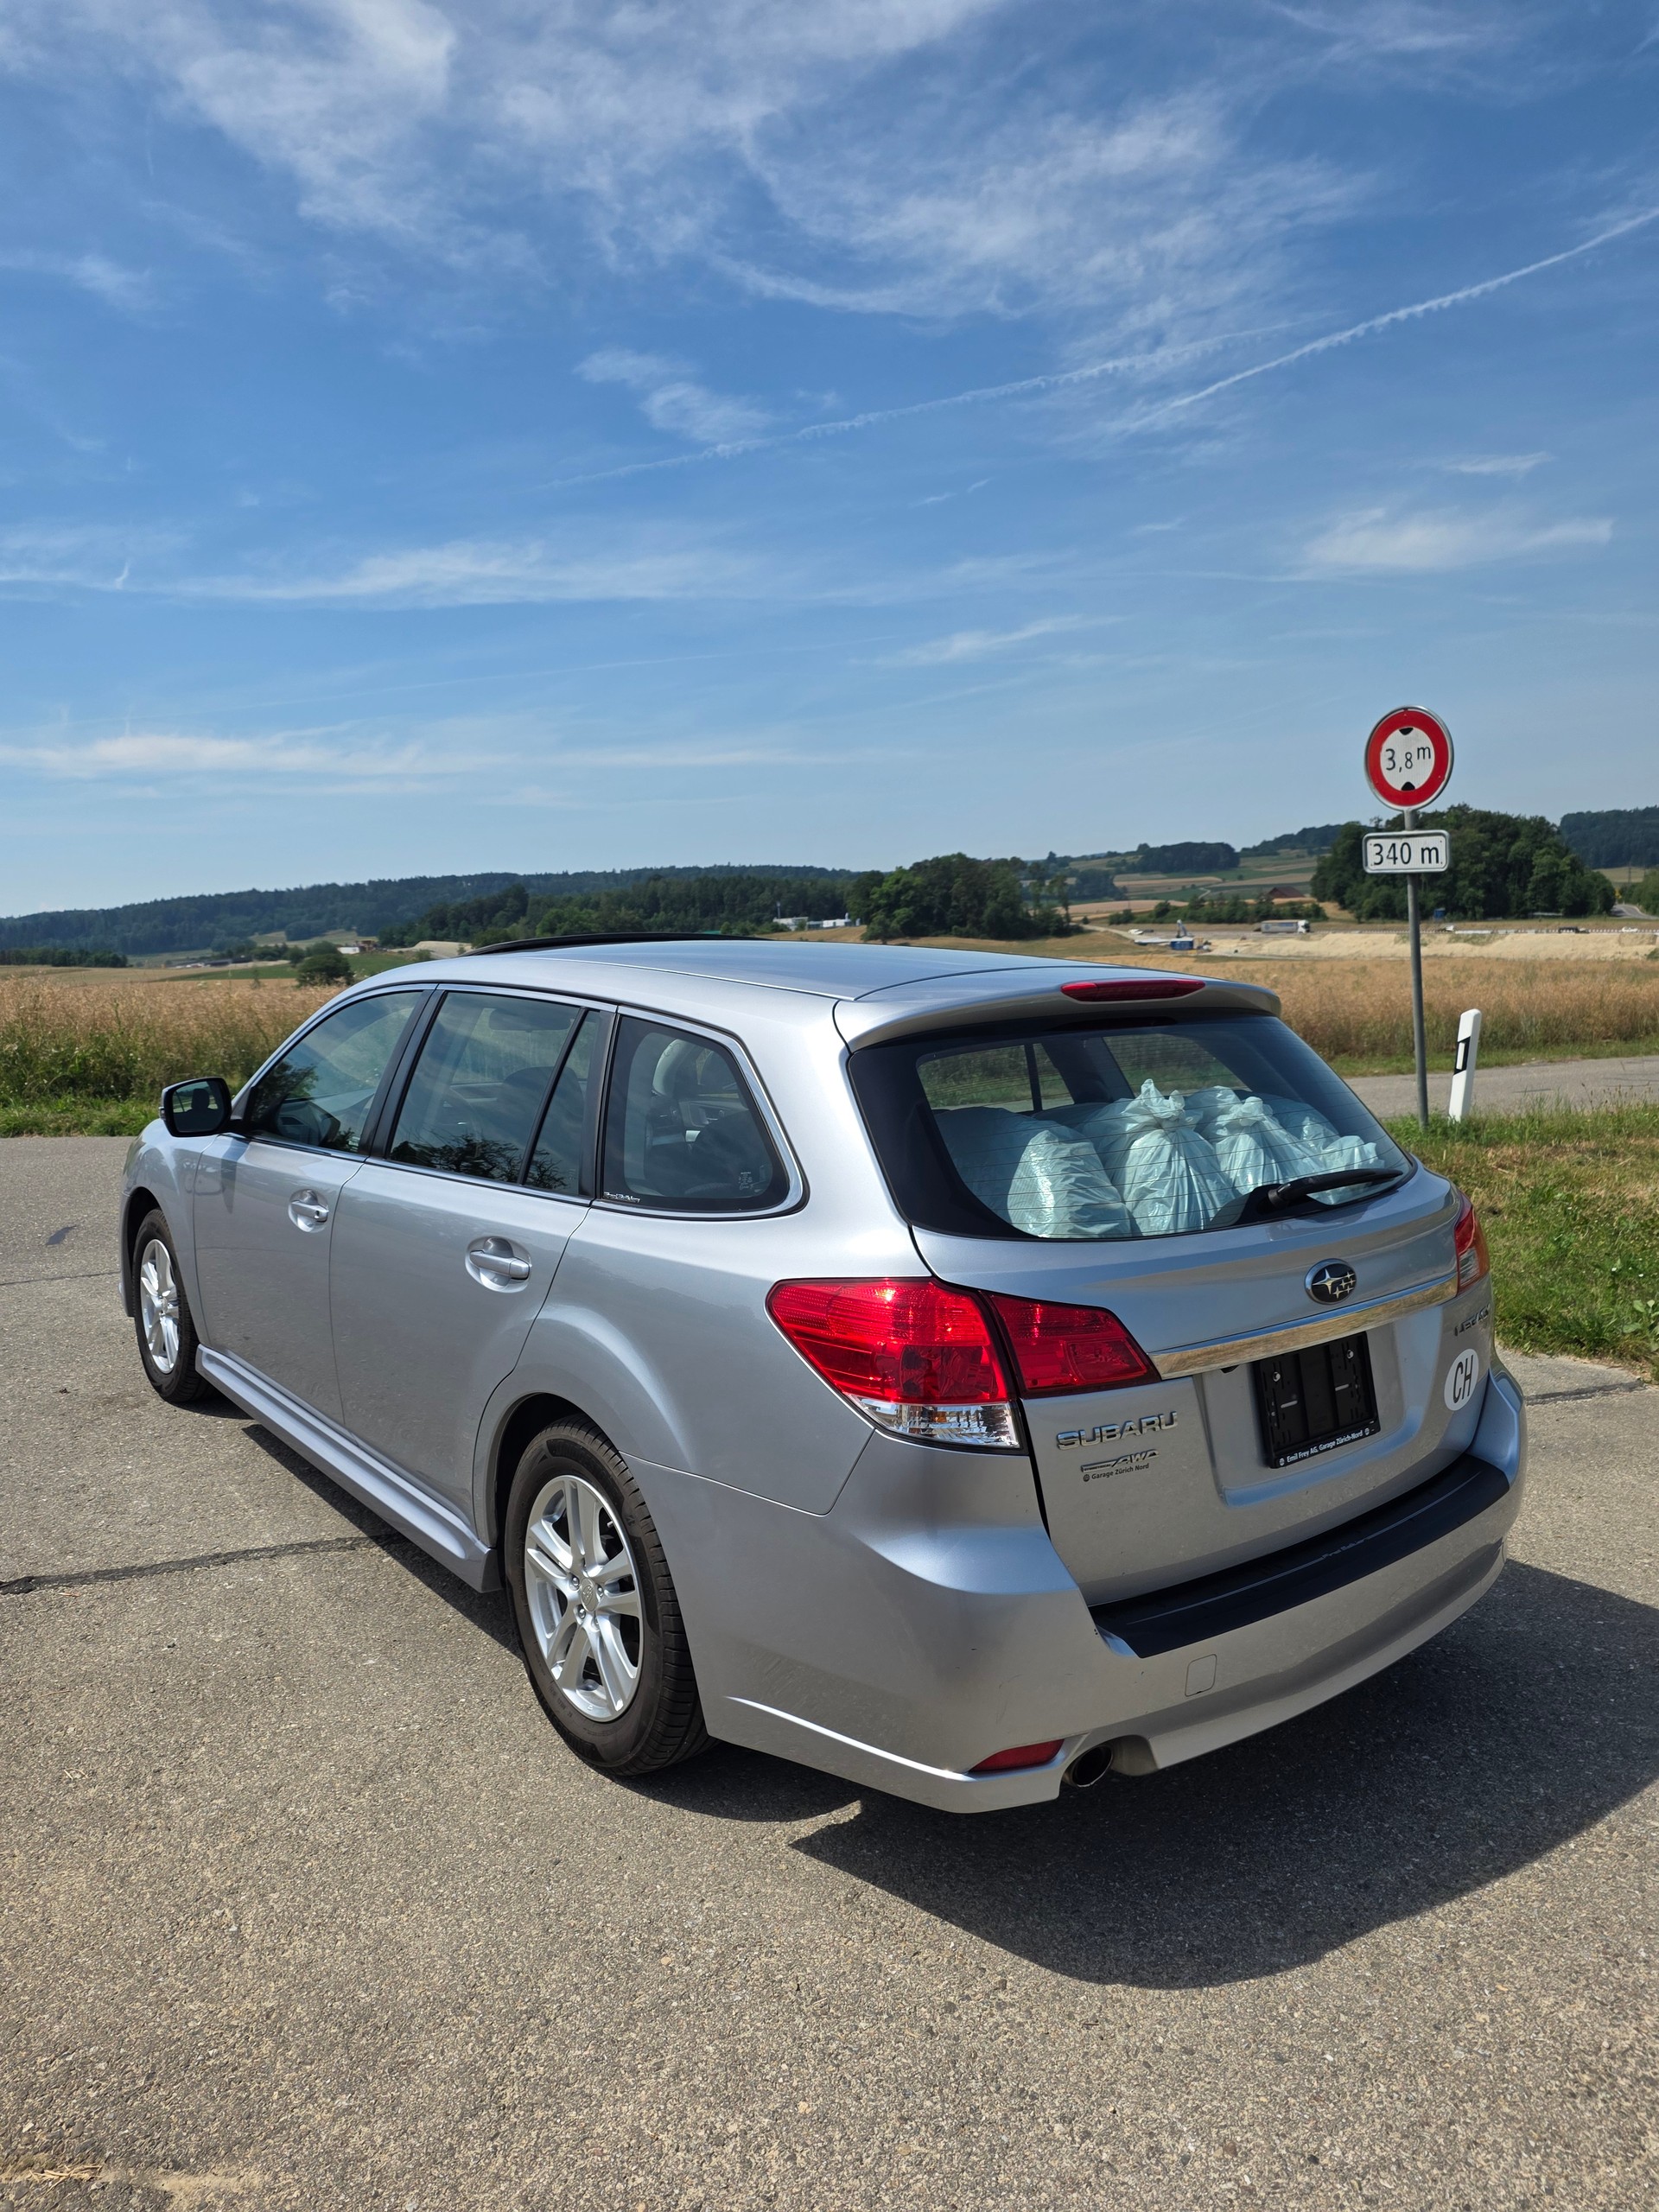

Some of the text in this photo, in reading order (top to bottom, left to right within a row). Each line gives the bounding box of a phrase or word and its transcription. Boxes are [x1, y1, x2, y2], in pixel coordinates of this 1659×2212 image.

[1373, 842, 1440, 866] 340 m
[1452, 1355, 1473, 1404] CH
[1057, 1411, 1179, 1450] SUBARU
[1115, 1449, 1159, 1465] AWD
[1287, 1453, 1298, 1463] Emil
[1299, 1450, 1309, 1459] Frey
[1319, 1440, 1335, 1451] Garage
[1091, 1463, 1149, 1479] Garage Zürich Nord
